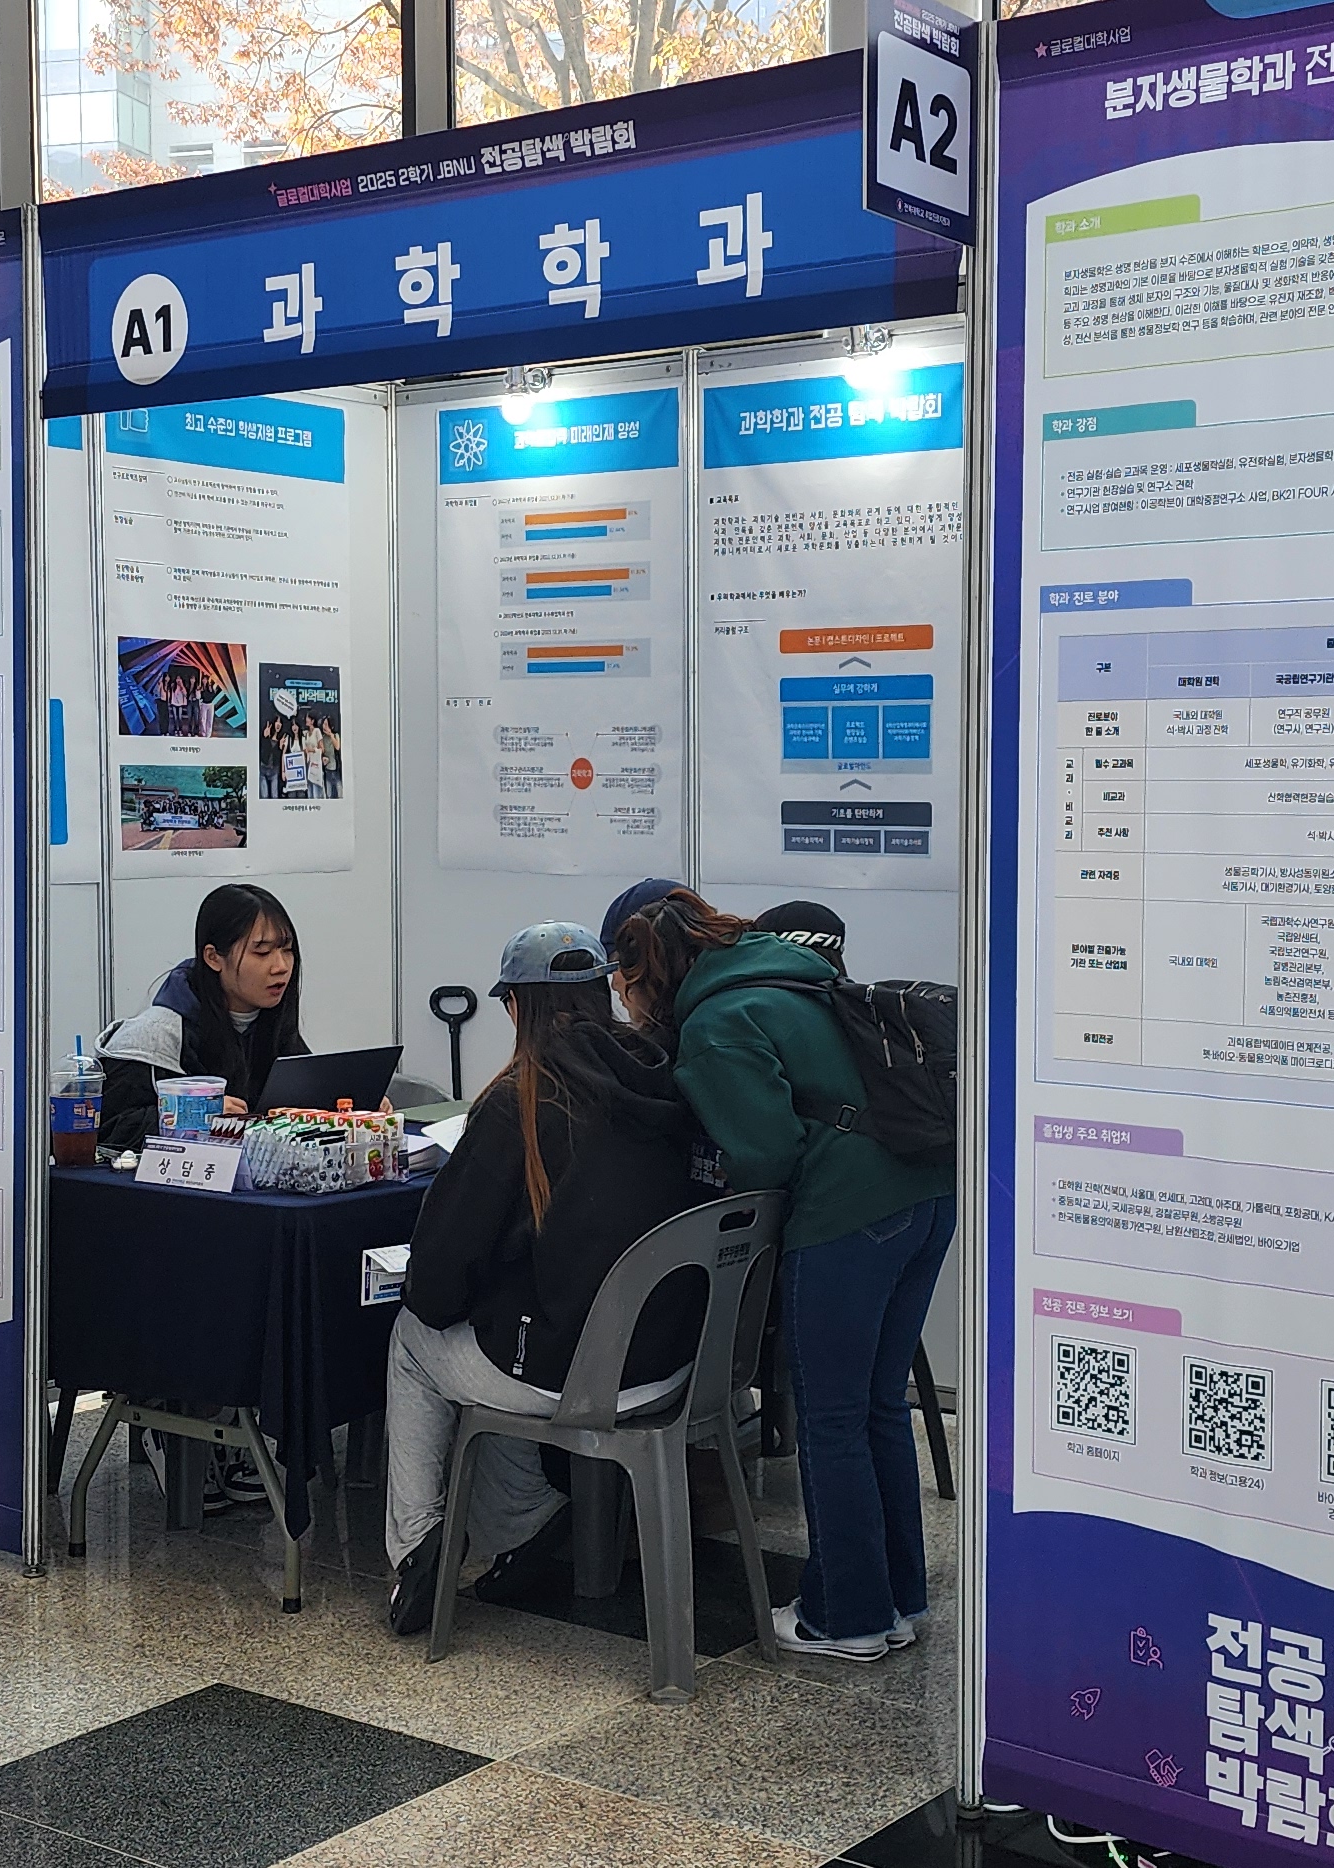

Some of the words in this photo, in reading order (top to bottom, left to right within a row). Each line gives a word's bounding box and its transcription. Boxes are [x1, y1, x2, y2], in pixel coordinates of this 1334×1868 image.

[893, 9, 930, 45] 전공탐색
[932, 26, 960, 57] 박람회
[1049, 26, 1132, 56] 글로컬대학사업
[1105, 49, 1295, 119] 분자생물학과
[889, 77, 958, 175] A2
[276, 179, 352, 207] 글로컬대학사업
[357, 170, 396, 193] 2025
[398, 164, 435, 185] 2학기
[437, 157, 475, 179] JBNU
[480, 135, 565, 175] 전공탐색
[570, 120, 637, 156] 박람회
[120, 303, 175, 360] A1
[185, 412, 205, 432] 최고
[207, 416, 236, 437] 수준의
[238, 420, 275, 442] 학생지원
[277, 426, 312, 448] 프로그램
[739, 406, 805, 435] 과학학과
[809, 402, 843, 429] 전공
[1051, 419, 1073, 433] 학과
[1075, 417, 1096, 432] 강점
[570, 423, 614, 445] 미래인재
[617, 420, 640, 439] 양성
[1067, 470, 1084, 482] 전공
[1150, 463, 1167, 475] 운영
[1066, 486, 1100, 498] 연구기관
[1136, 482, 1144, 493] 및
[1146, 480, 1173, 492] 연구소
[1247, 490, 1269, 502] 사업,
[1271, 488, 1295, 500] BK21
[1297, 486, 1328, 498] FOUR
[1048, 592, 1070, 605] 학과
[1072, 591, 1094, 605] 진로
[1097, 590, 1119, 604] 분야
[1076, 1127, 1098, 1139] 주요
[1100, 1129, 1130, 1144] 취업처
[1041, 1297, 1062, 1312] 전공
[1065, 1300, 1086, 1314] 진로
[1088, 1303, 1109, 1317] 정보
[1112, 1307, 1132, 1321] 보기
[1066, 1442, 1084, 1454] 학과
[1189, 1465, 1207, 1478] 학과
[1206, 1613, 1326, 1703] 전공
[1205, 1681, 1327, 1773] 탐색
